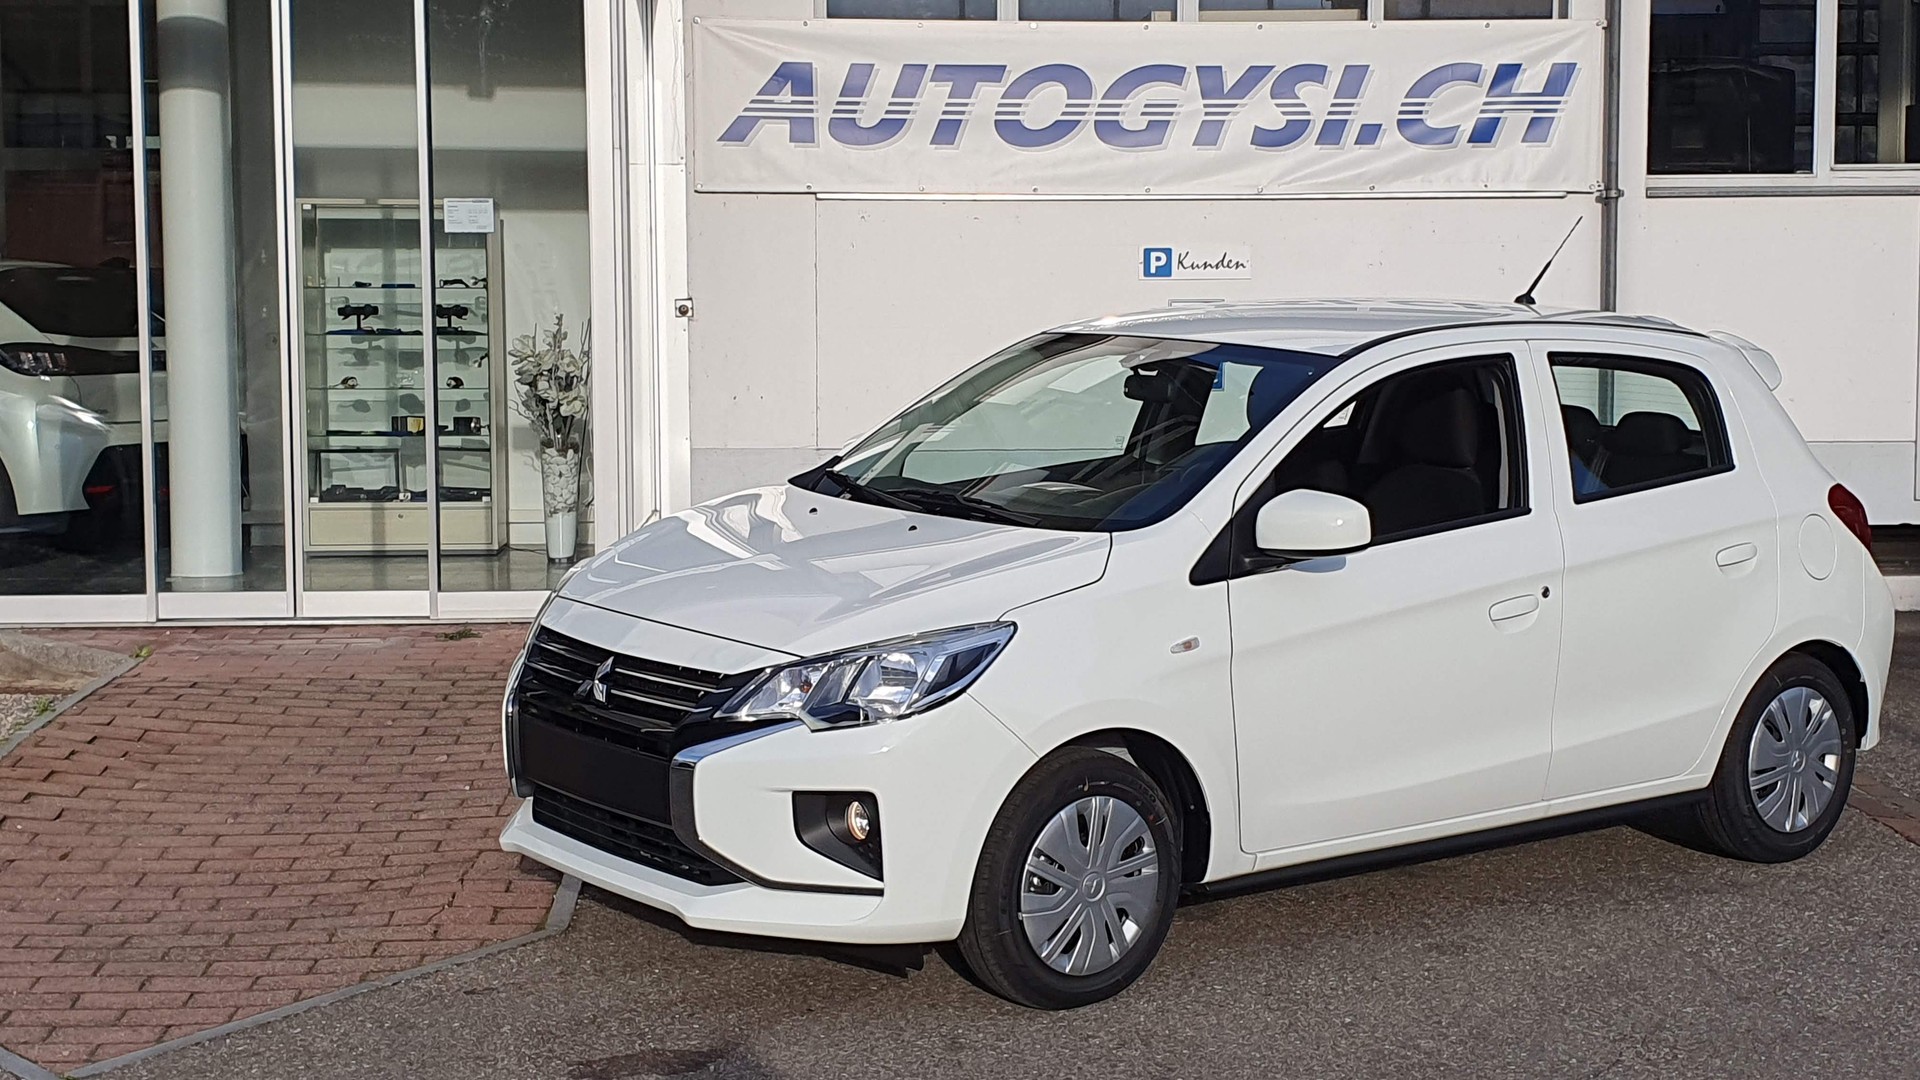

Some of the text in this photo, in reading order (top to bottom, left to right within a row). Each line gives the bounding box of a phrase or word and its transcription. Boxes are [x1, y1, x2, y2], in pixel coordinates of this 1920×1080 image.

[717, 61, 1580, 149] AUTOGYSI.CH
[1150, 251, 1247, 274] P Kunden
